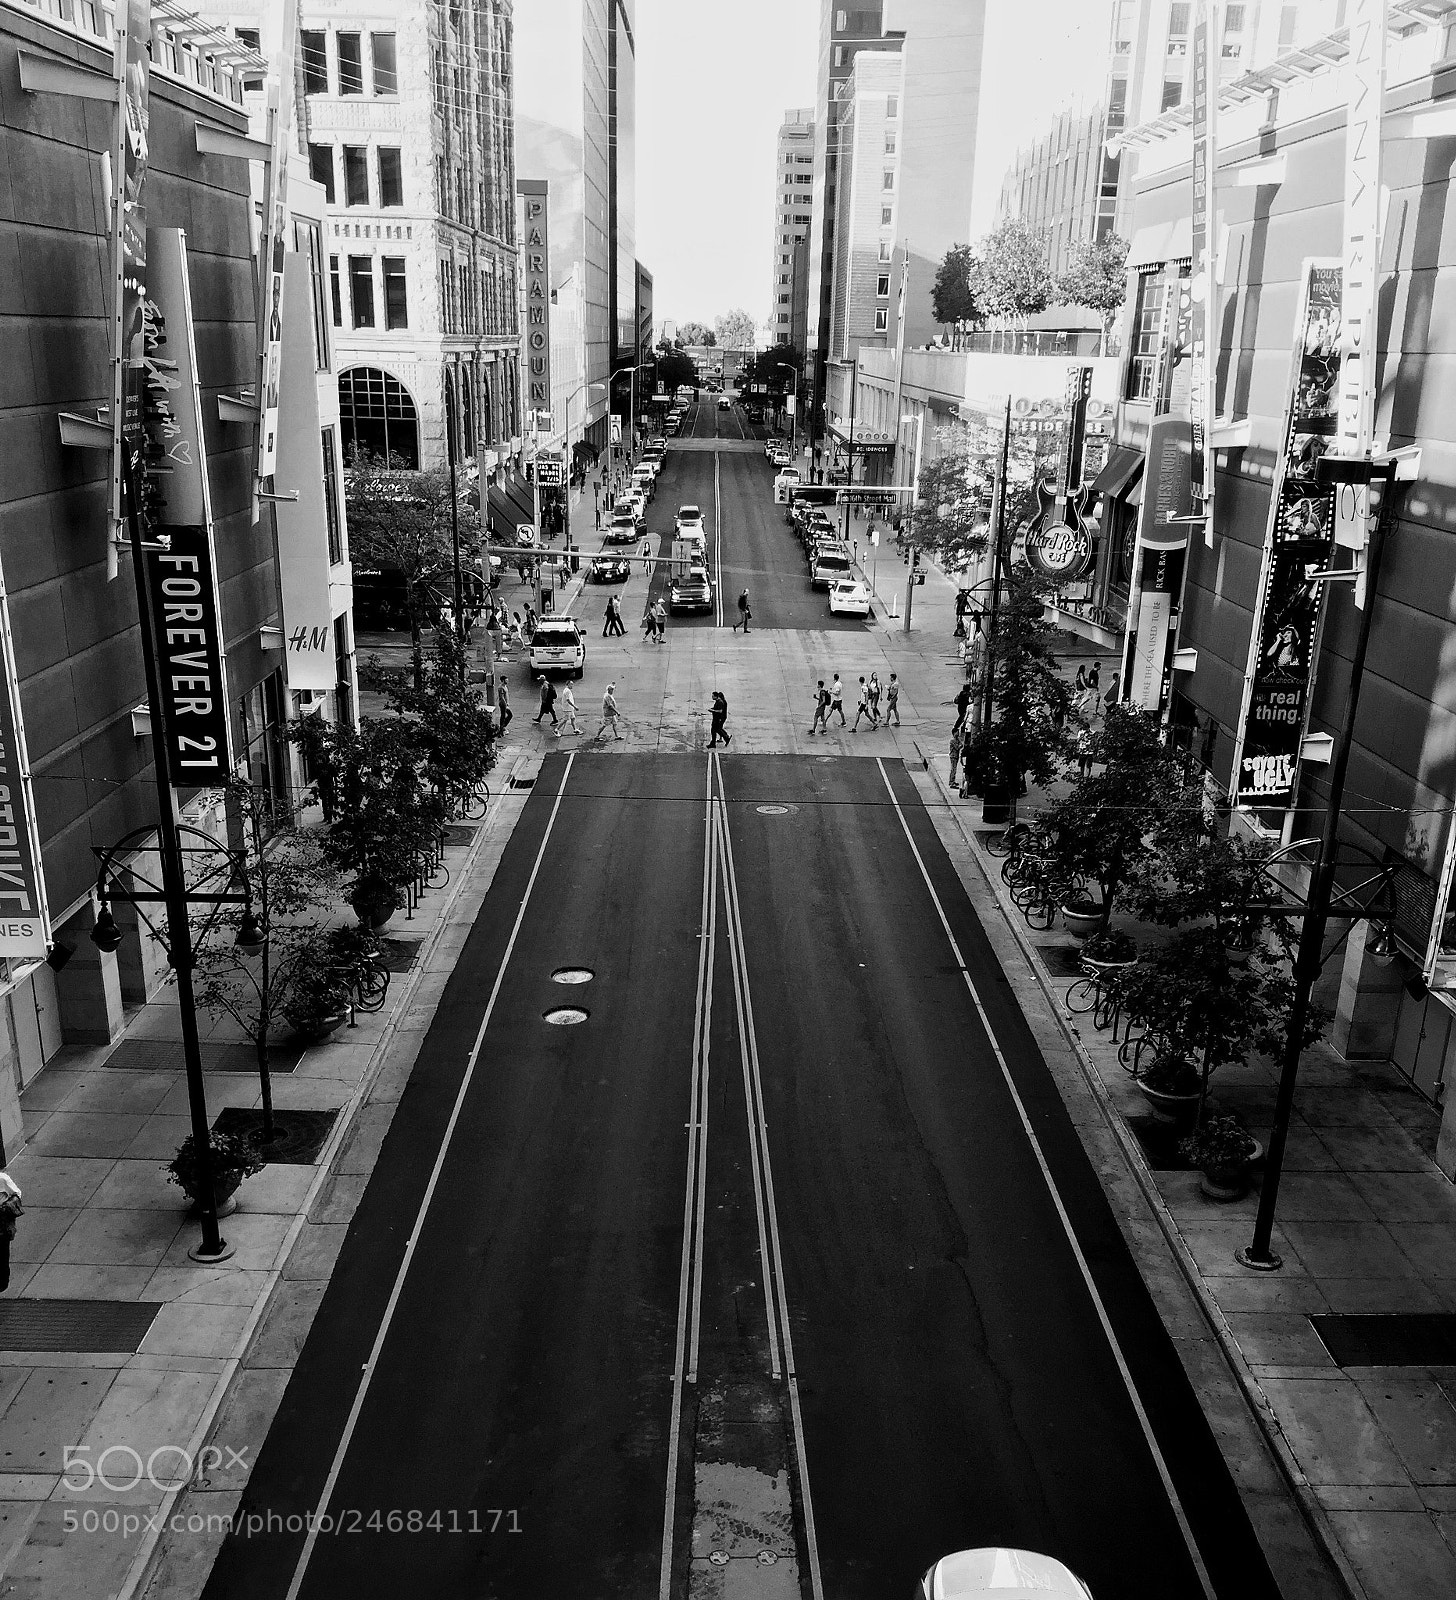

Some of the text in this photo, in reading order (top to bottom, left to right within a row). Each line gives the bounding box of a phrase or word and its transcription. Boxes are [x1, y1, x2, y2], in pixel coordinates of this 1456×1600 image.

[1011, 420, 1104, 433] RESIDEES
[1057, 533, 1087, 557] Rock
[1048, 552, 1066, 562] CAFE
[1156, 568, 1166, 589] RICK
[1153, 601, 1161, 609] BE
[1152, 611, 1160, 622] TO
[288, 626, 328, 652] H&M
[1149, 626, 1158, 647] USED
[158, 555, 219, 767] FOREVER 21
[1147, 649, 1155, 664] SEA
[1144, 665, 1152, 680] THE
[1269, 690, 1301, 705] real
[1255, 705, 1301, 725] thing.
[1242, 754, 1294, 772] COYOTE
[1253, 768, 1296, 788] UGLY
